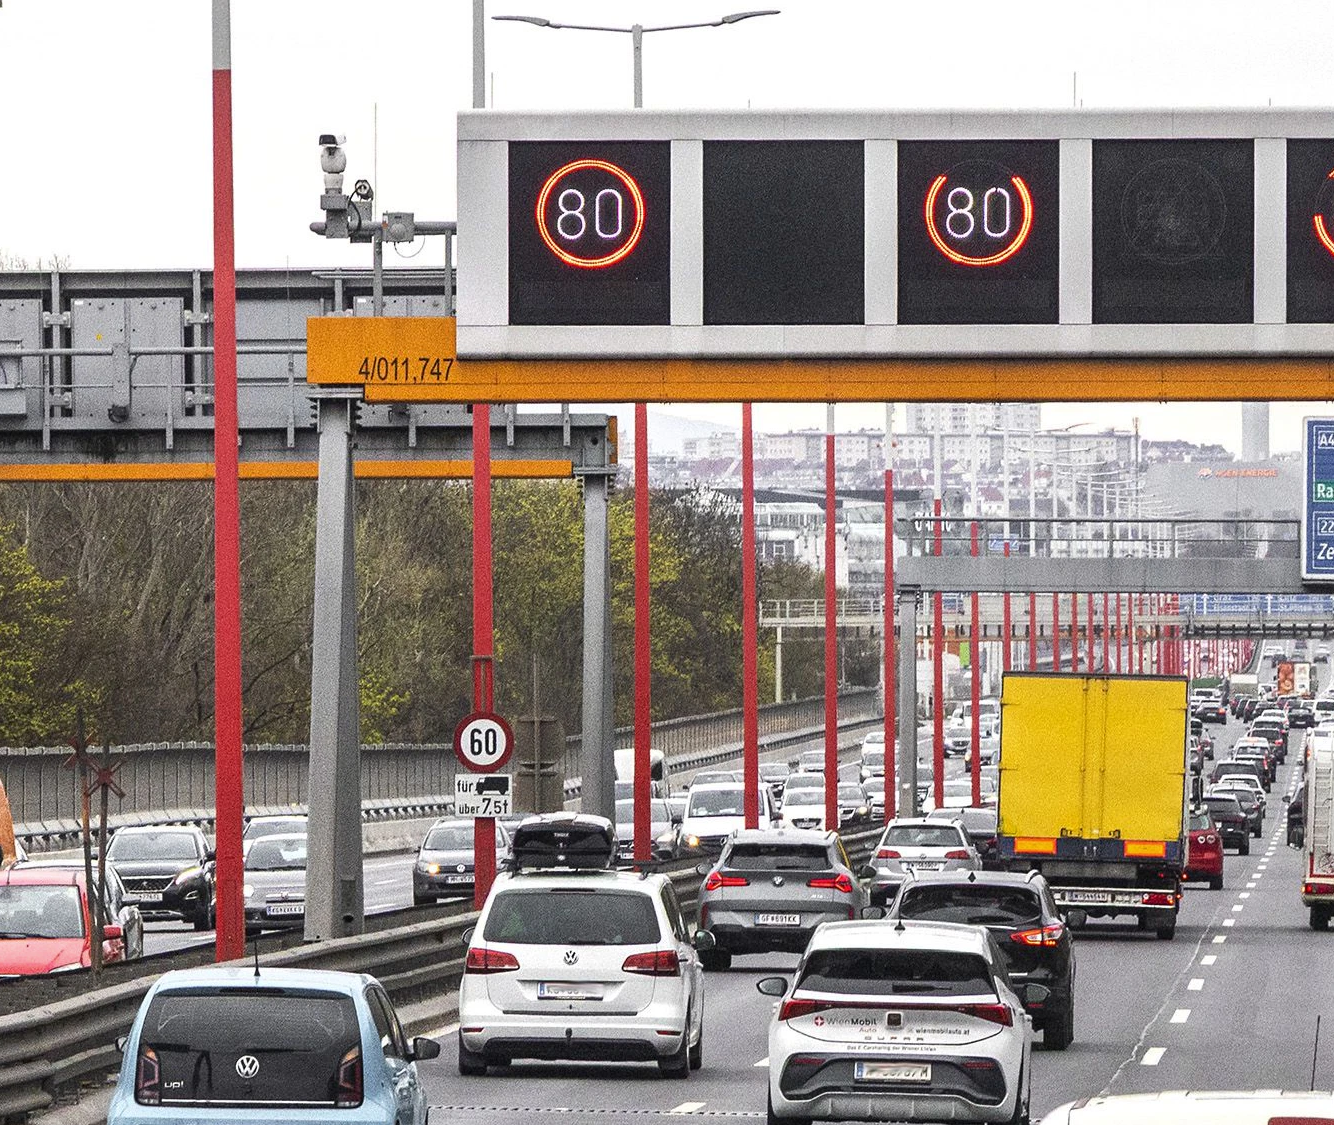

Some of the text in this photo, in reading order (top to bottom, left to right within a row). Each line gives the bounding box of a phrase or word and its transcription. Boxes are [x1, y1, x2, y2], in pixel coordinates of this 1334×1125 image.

[557, 188, 622, 240] 80
[946, 186, 1010, 238] 80
[358, 356, 454, 384] 4/011,747
[470, 728, 497, 756] 60
[457, 779, 473, 793] für
[459, 802, 480, 815] über
[826, 1016, 877, 1026] WienMobil
[164, 1080, 184, 1089] up!
